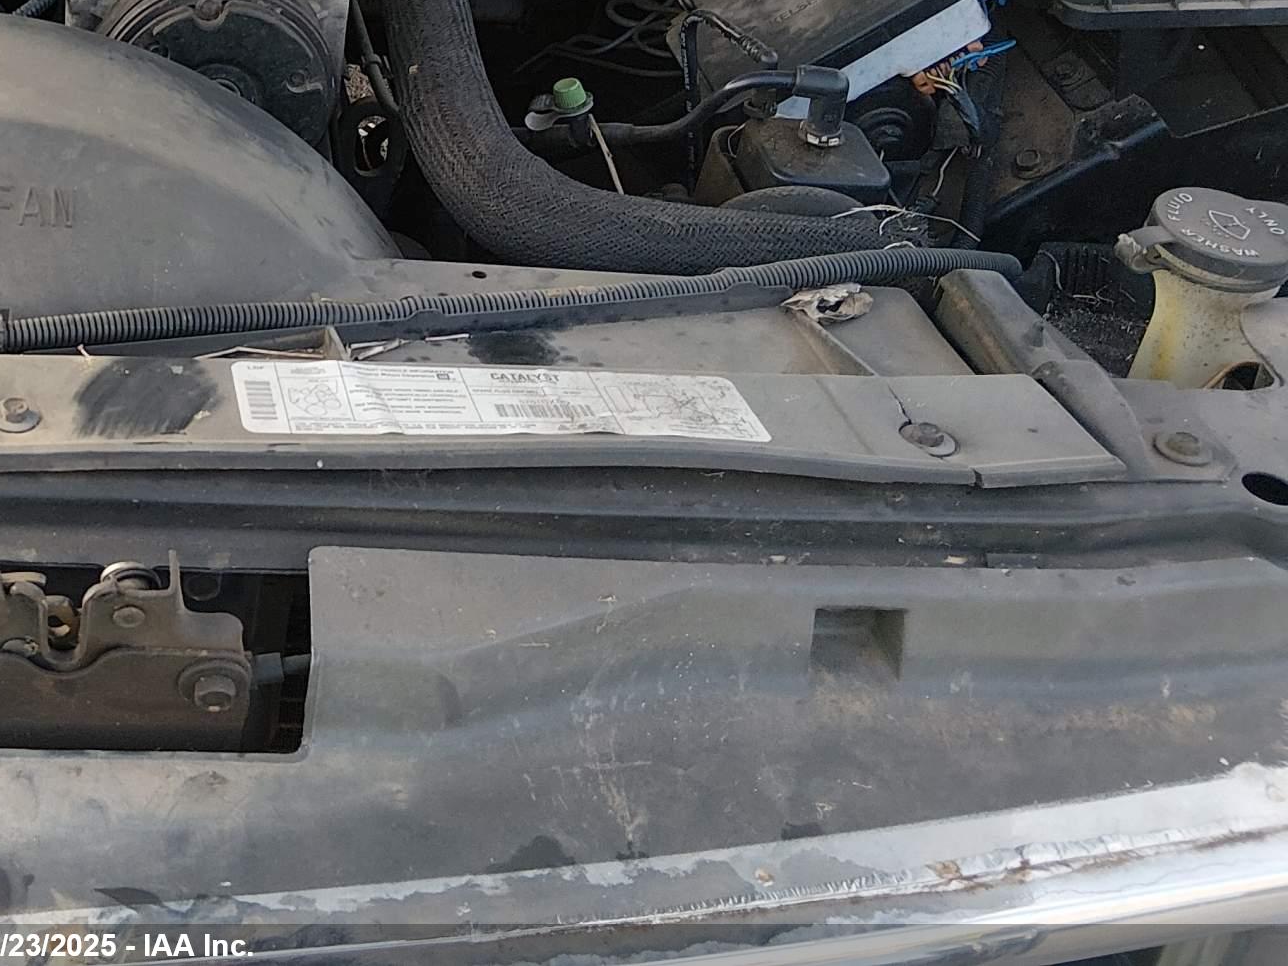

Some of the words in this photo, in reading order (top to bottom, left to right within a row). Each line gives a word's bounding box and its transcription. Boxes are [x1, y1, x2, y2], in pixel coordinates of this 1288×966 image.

[1167, 192, 1193, 222] FLUID
[1245, 207, 1285, 235] ONLY
[1180, 228, 1260, 258] WASHER
[490, 372, 560, 382] CATALYST
